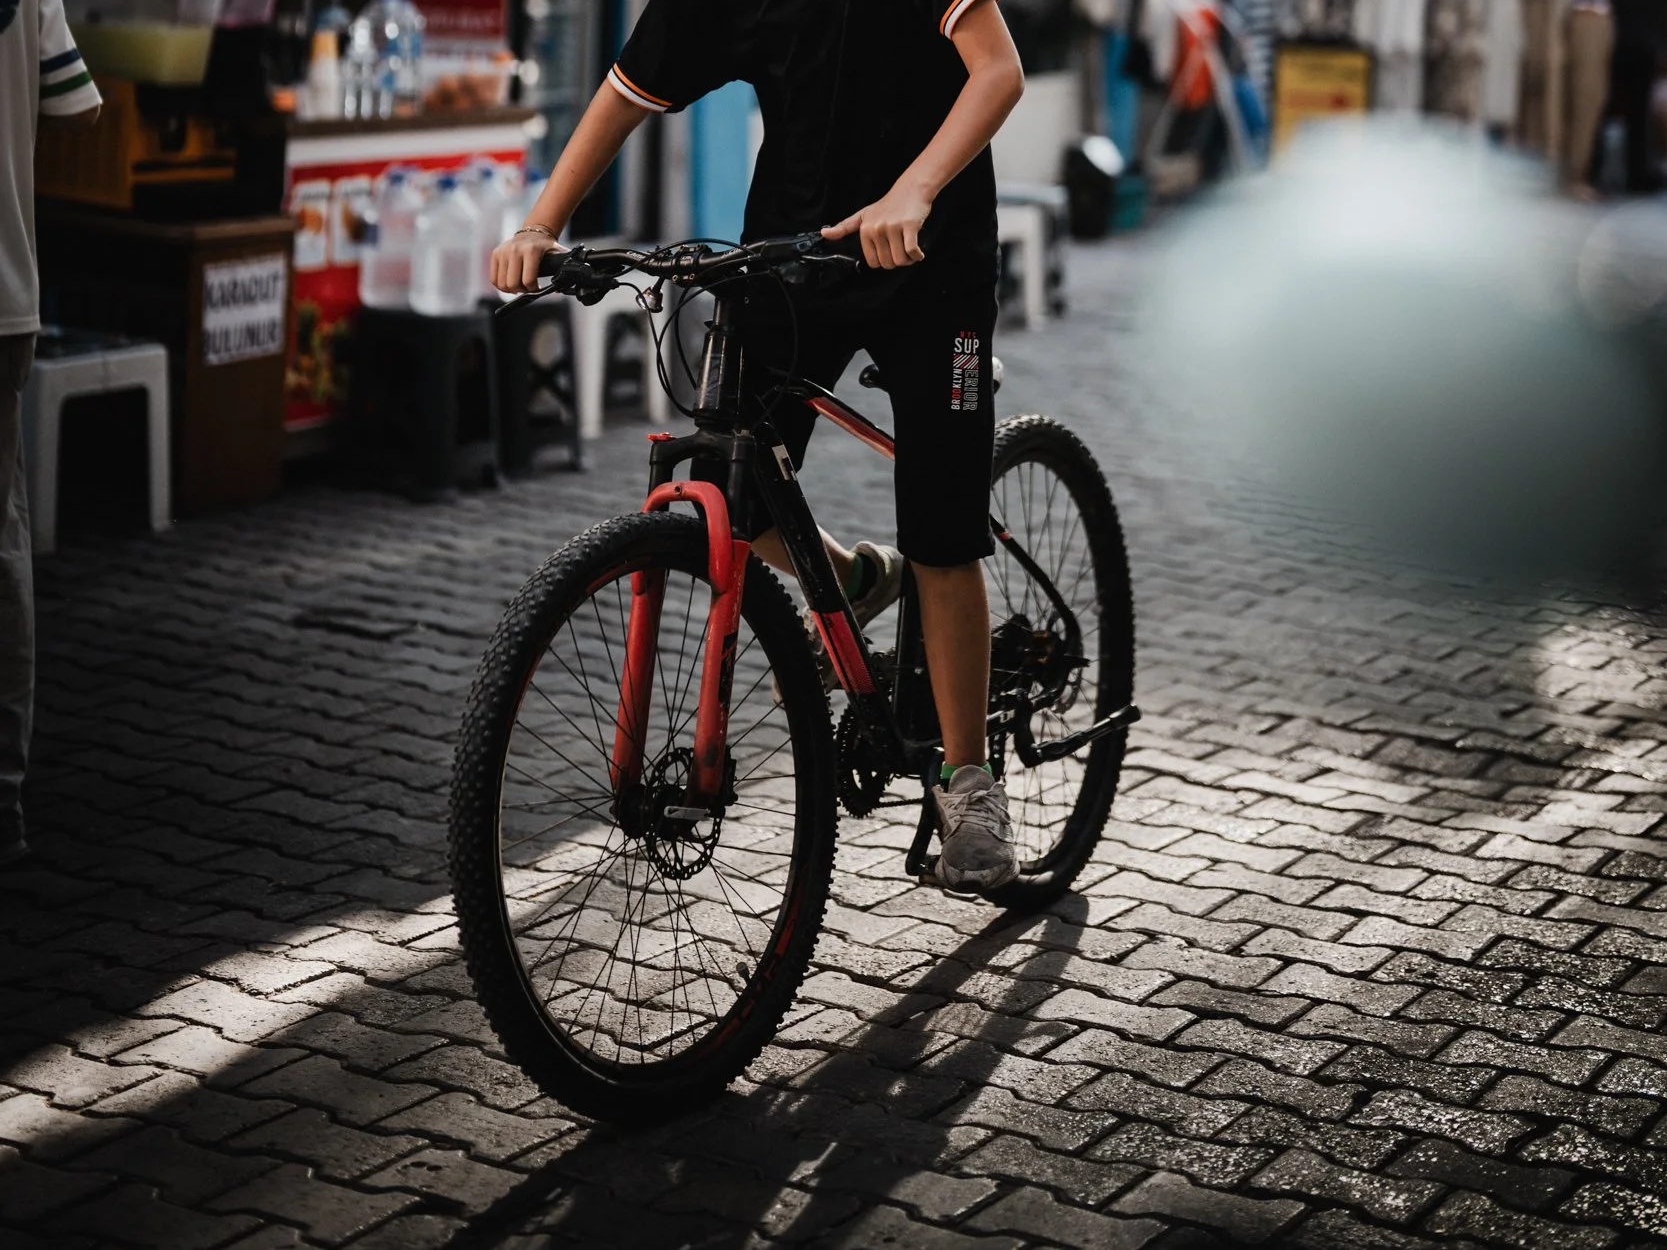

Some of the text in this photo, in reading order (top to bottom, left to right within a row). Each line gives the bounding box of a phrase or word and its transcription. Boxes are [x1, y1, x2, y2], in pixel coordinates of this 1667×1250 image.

[954, 337, 980, 354] SUP
[951, 368, 963, 410] BROOKLYN
[963, 369, 979, 411] ERIOR
